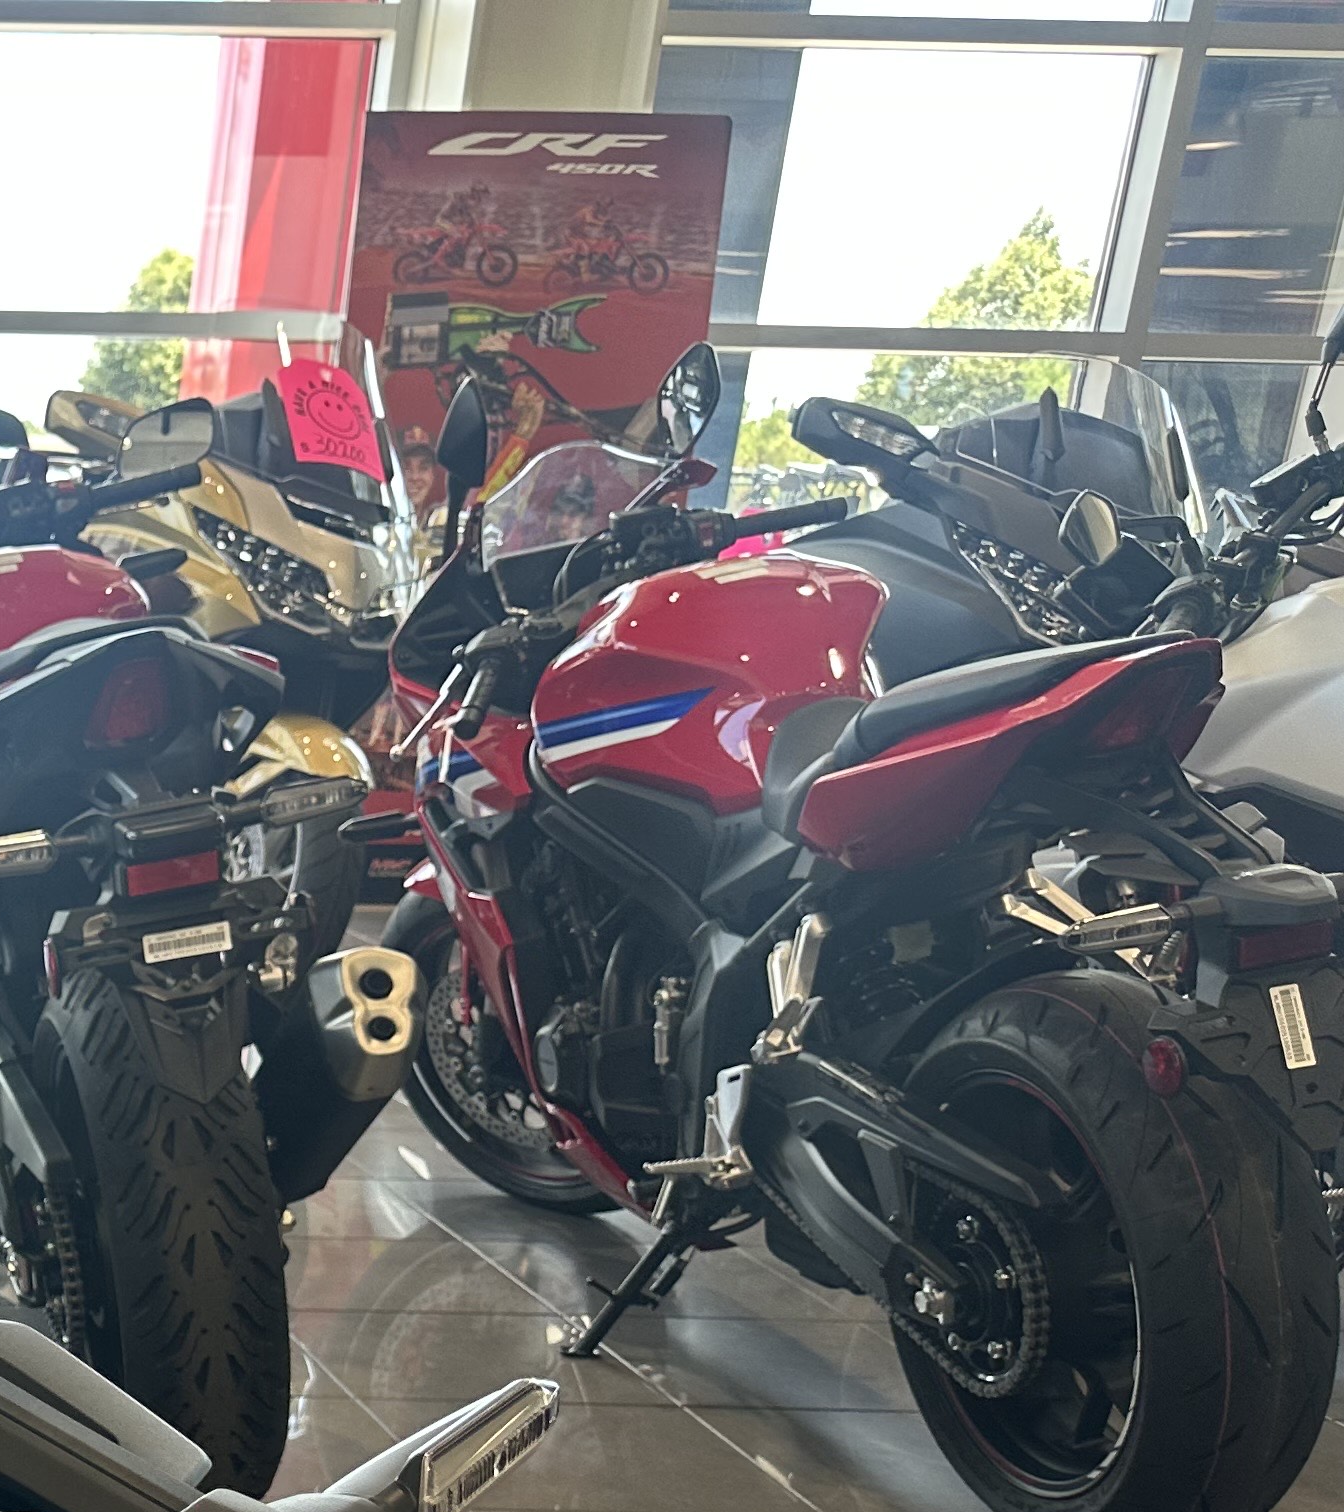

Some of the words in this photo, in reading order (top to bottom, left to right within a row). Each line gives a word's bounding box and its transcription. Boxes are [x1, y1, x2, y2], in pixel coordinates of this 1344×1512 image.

[427, 132, 668, 157] CRF
[546, 162, 660, 179] 450R
[293, 387, 308, 416] HAVE
